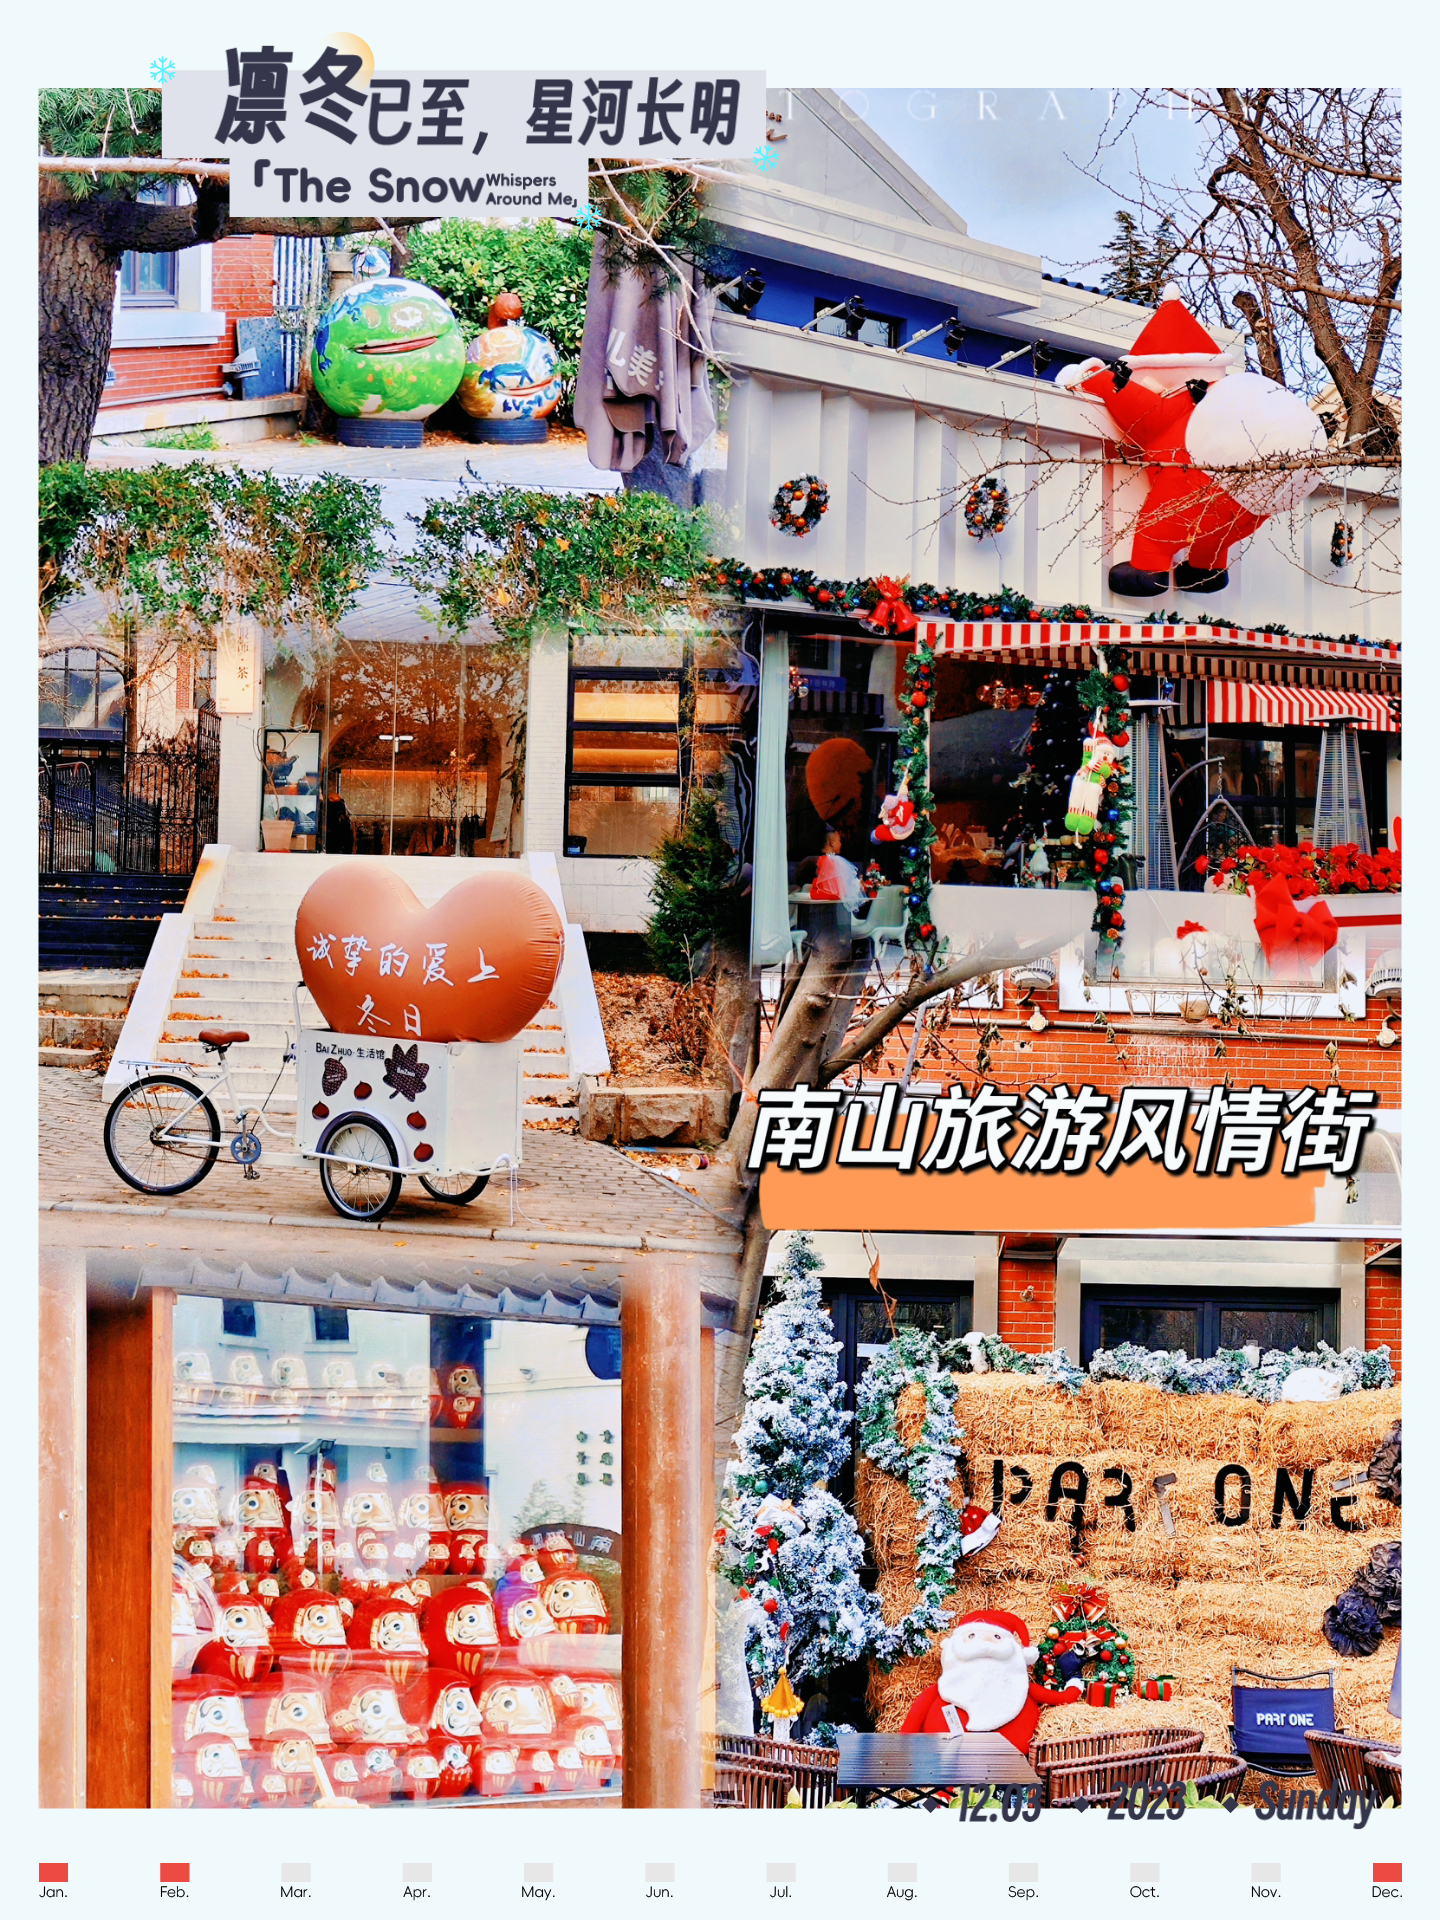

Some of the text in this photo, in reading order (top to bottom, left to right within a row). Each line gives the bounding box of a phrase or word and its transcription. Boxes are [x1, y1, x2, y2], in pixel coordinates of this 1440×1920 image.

[306, 932, 501, 987] 诚挚的爱上
[356, 993, 423, 1037] 冬日
[1256, 1712, 1315, 1727] PART ONE
